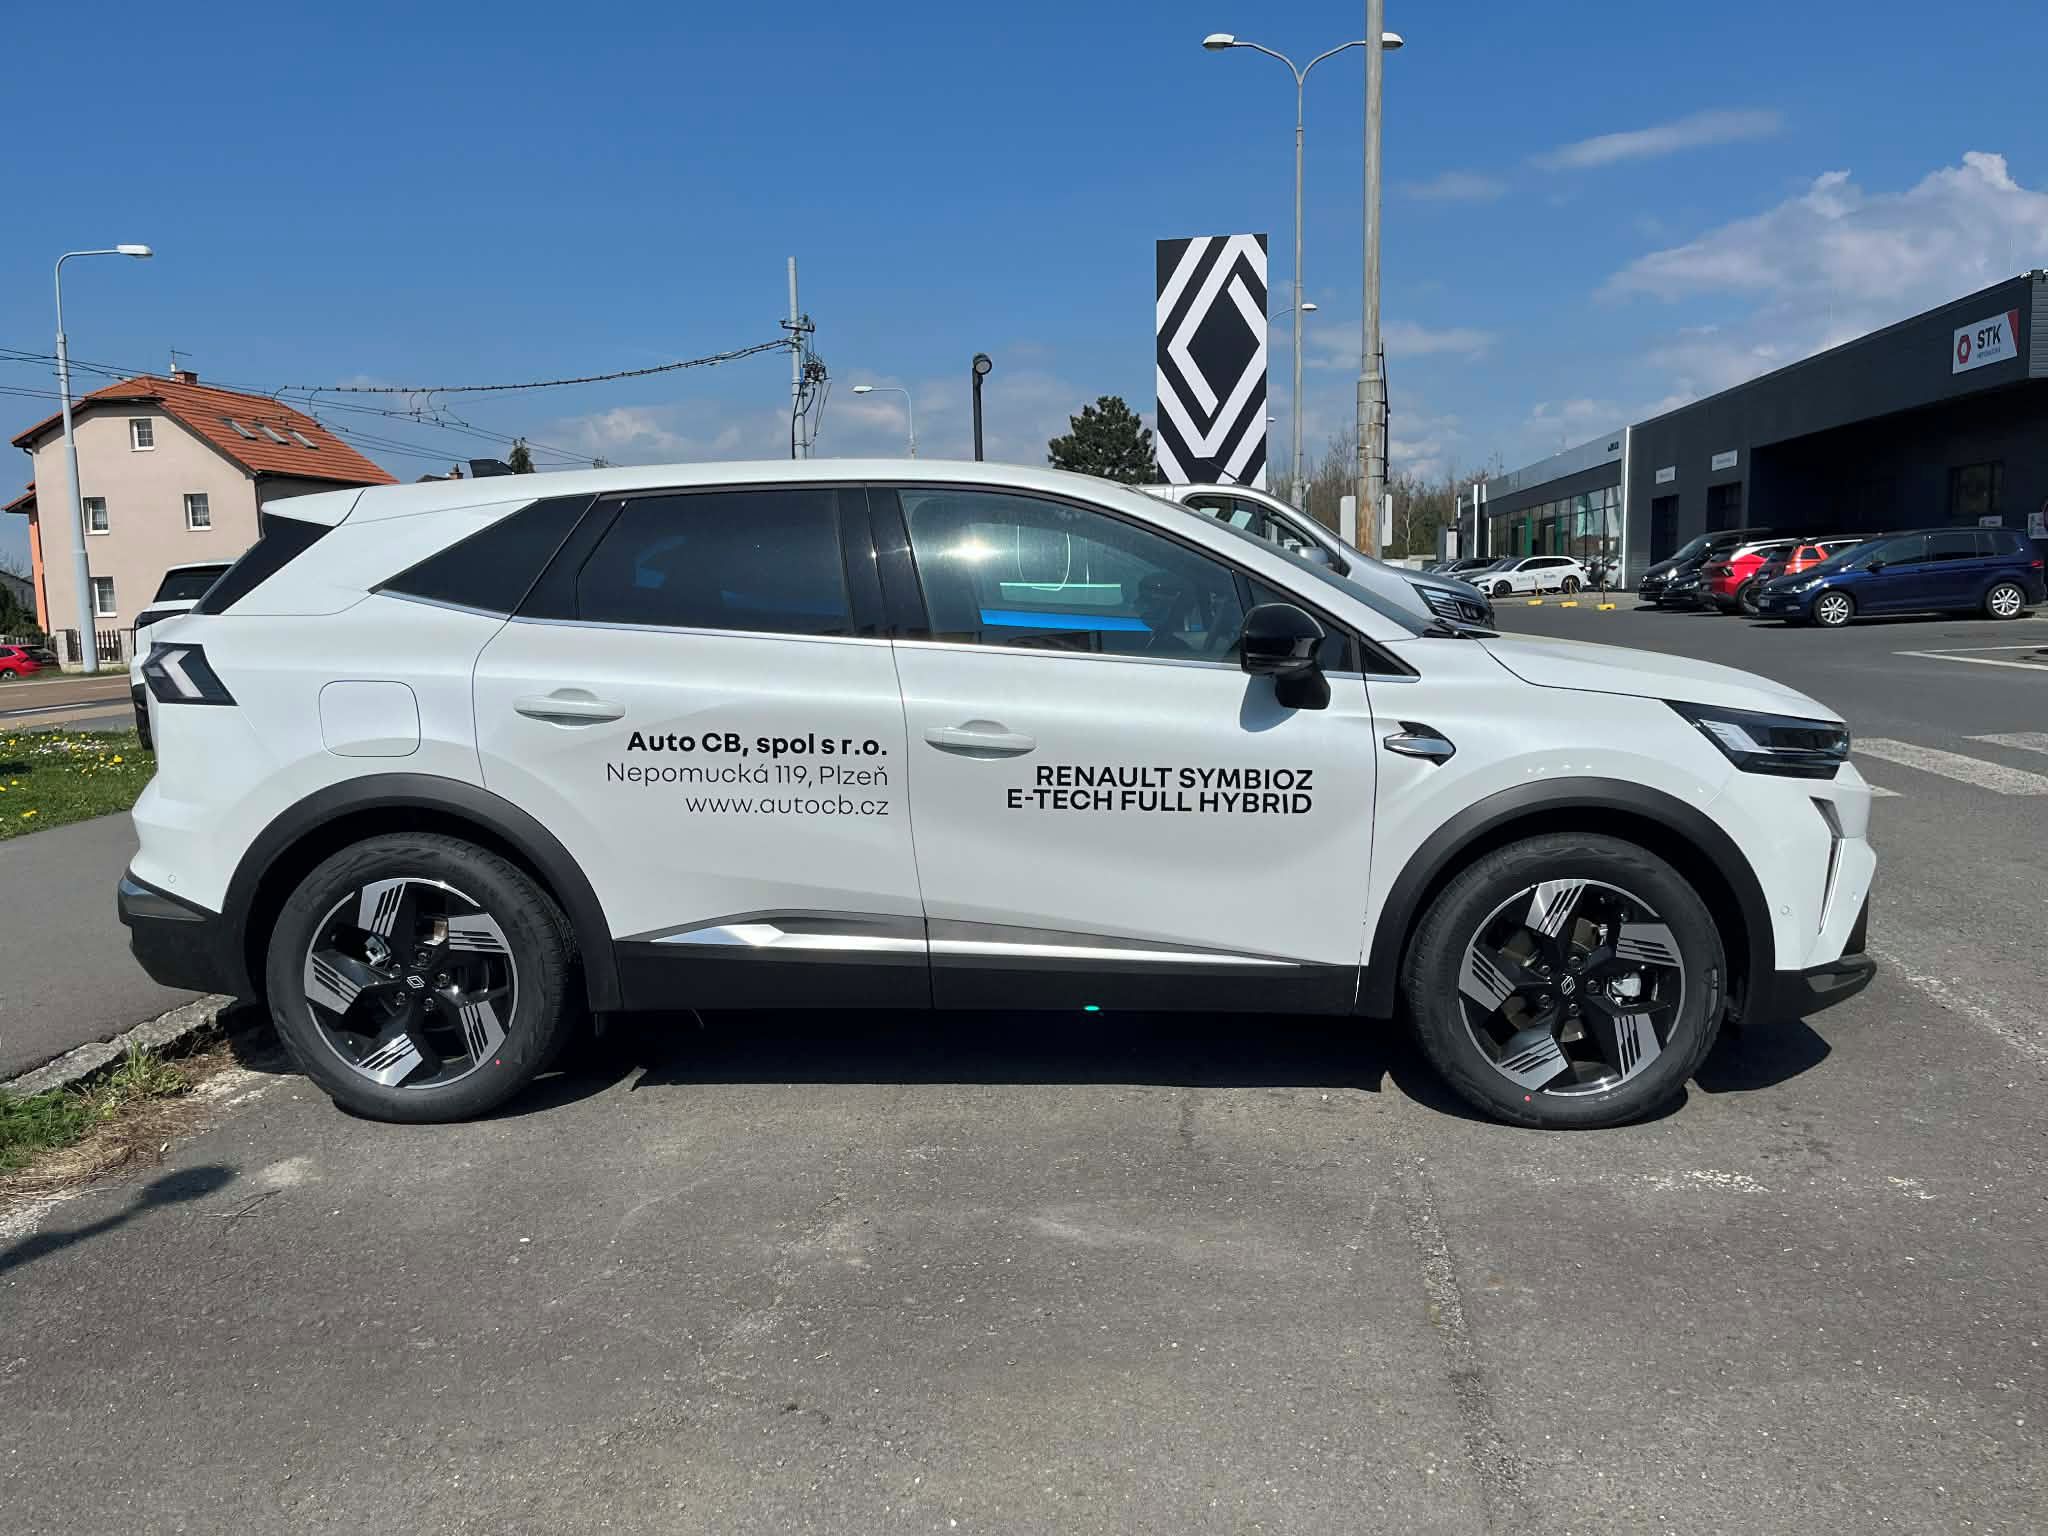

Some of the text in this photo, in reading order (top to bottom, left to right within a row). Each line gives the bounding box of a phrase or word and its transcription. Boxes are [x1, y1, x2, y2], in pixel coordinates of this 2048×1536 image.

[1977, 323, 2002, 349] STK
[626, 731, 888, 759] Auto CB, spol s r.o.
[606, 762, 889, 788] Nepomucká 119, Plzeň
[1035, 765, 1314, 791] RENAULT SYMBIOZ
[685, 794, 890, 816] www.autocb.cz
[1006, 788, 1313, 814] E-TECH FULL HYBRID
